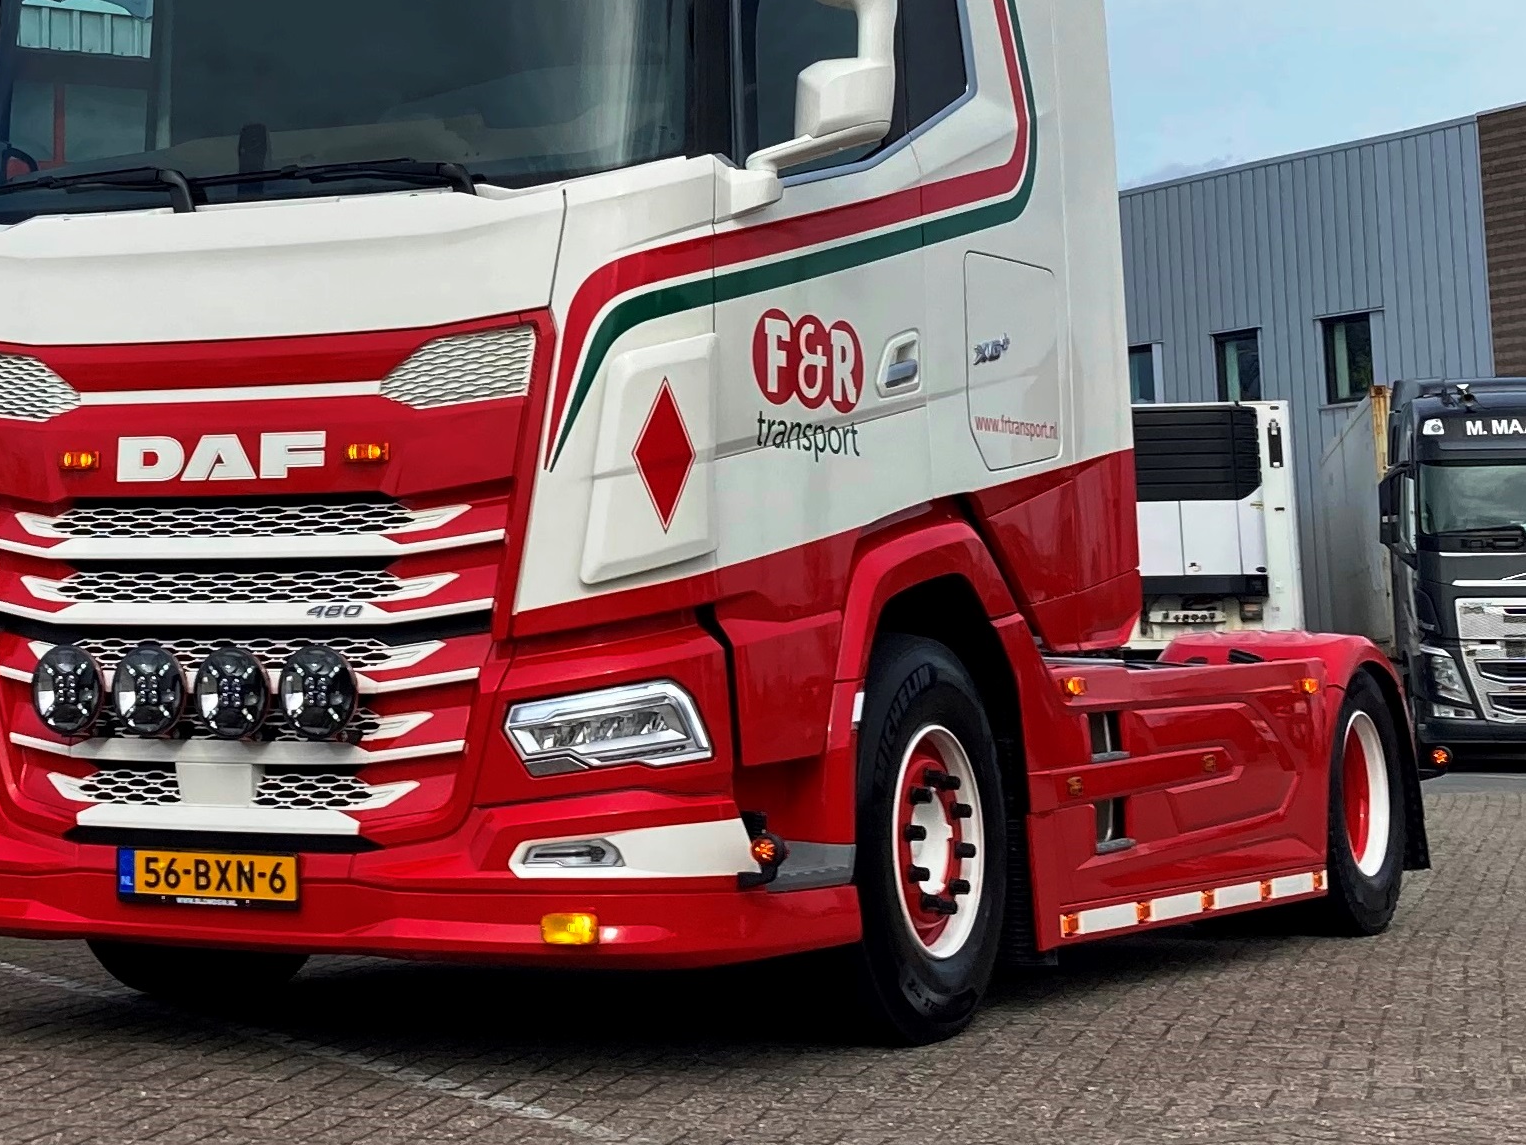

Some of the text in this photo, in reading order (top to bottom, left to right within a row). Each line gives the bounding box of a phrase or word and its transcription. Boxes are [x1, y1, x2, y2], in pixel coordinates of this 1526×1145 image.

[763, 316, 858, 405] F&R
[756, 410, 861, 463] transport
[1465, 418, 1526, 436] M. MA
[116, 430, 327, 483] DAF
[306, 604, 364, 619] 480
[143, 856, 287, 895] 56-BXN-6
